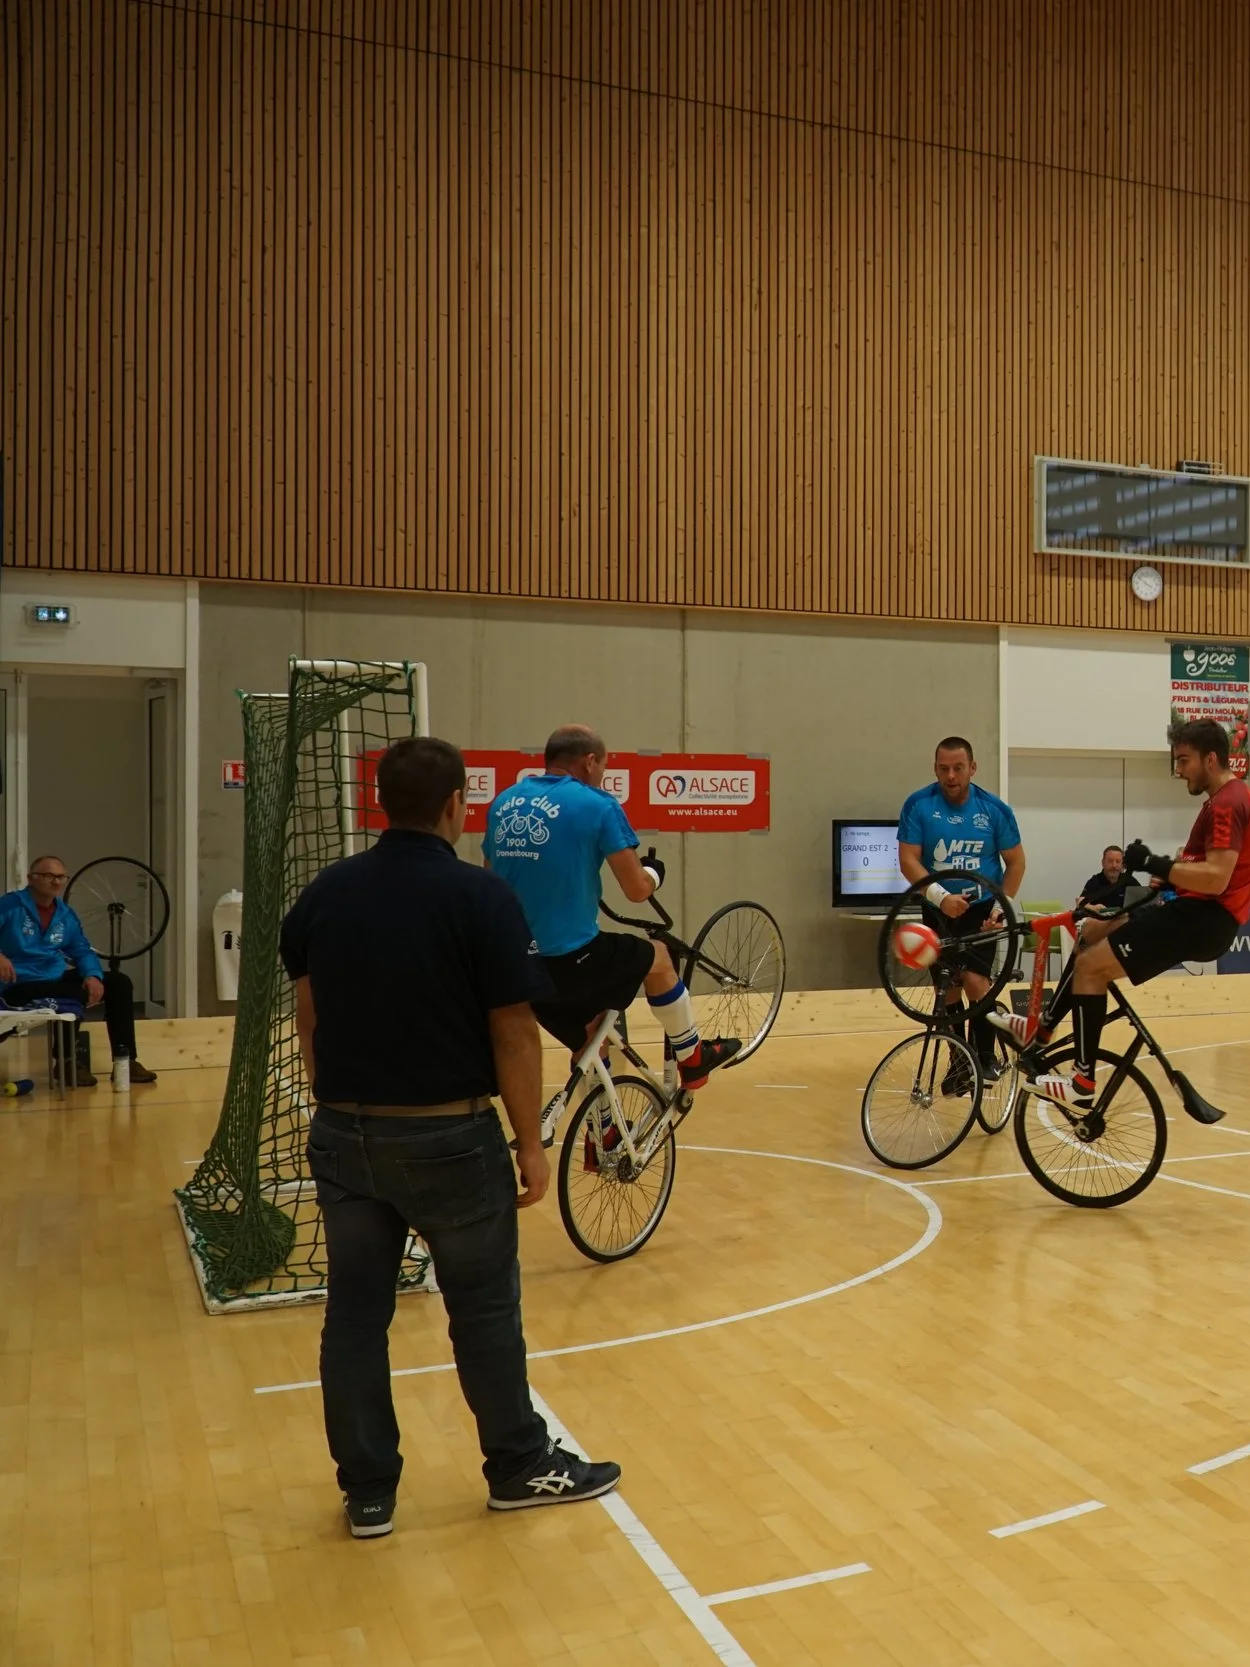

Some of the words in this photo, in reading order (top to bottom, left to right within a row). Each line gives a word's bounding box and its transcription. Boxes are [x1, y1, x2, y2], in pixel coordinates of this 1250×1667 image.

[1171, 681, 1249, 693] DISTRIBUTEUR
[1172, 695, 1202, 703] FRUITS
[1211, 695, 1249, 704] LÉGUMES
[689, 777, 749, 793] ALSACE
[529, 794, 561, 819] club
[668, 807, 738, 816] www.alsace.eu
[505, 837, 526, 847] 1900
[842, 844, 868, 852] GRAND
[869, 844, 882, 852] EST
[947, 839, 985, 857] MTE
[862, 856, 869, 867] 0
